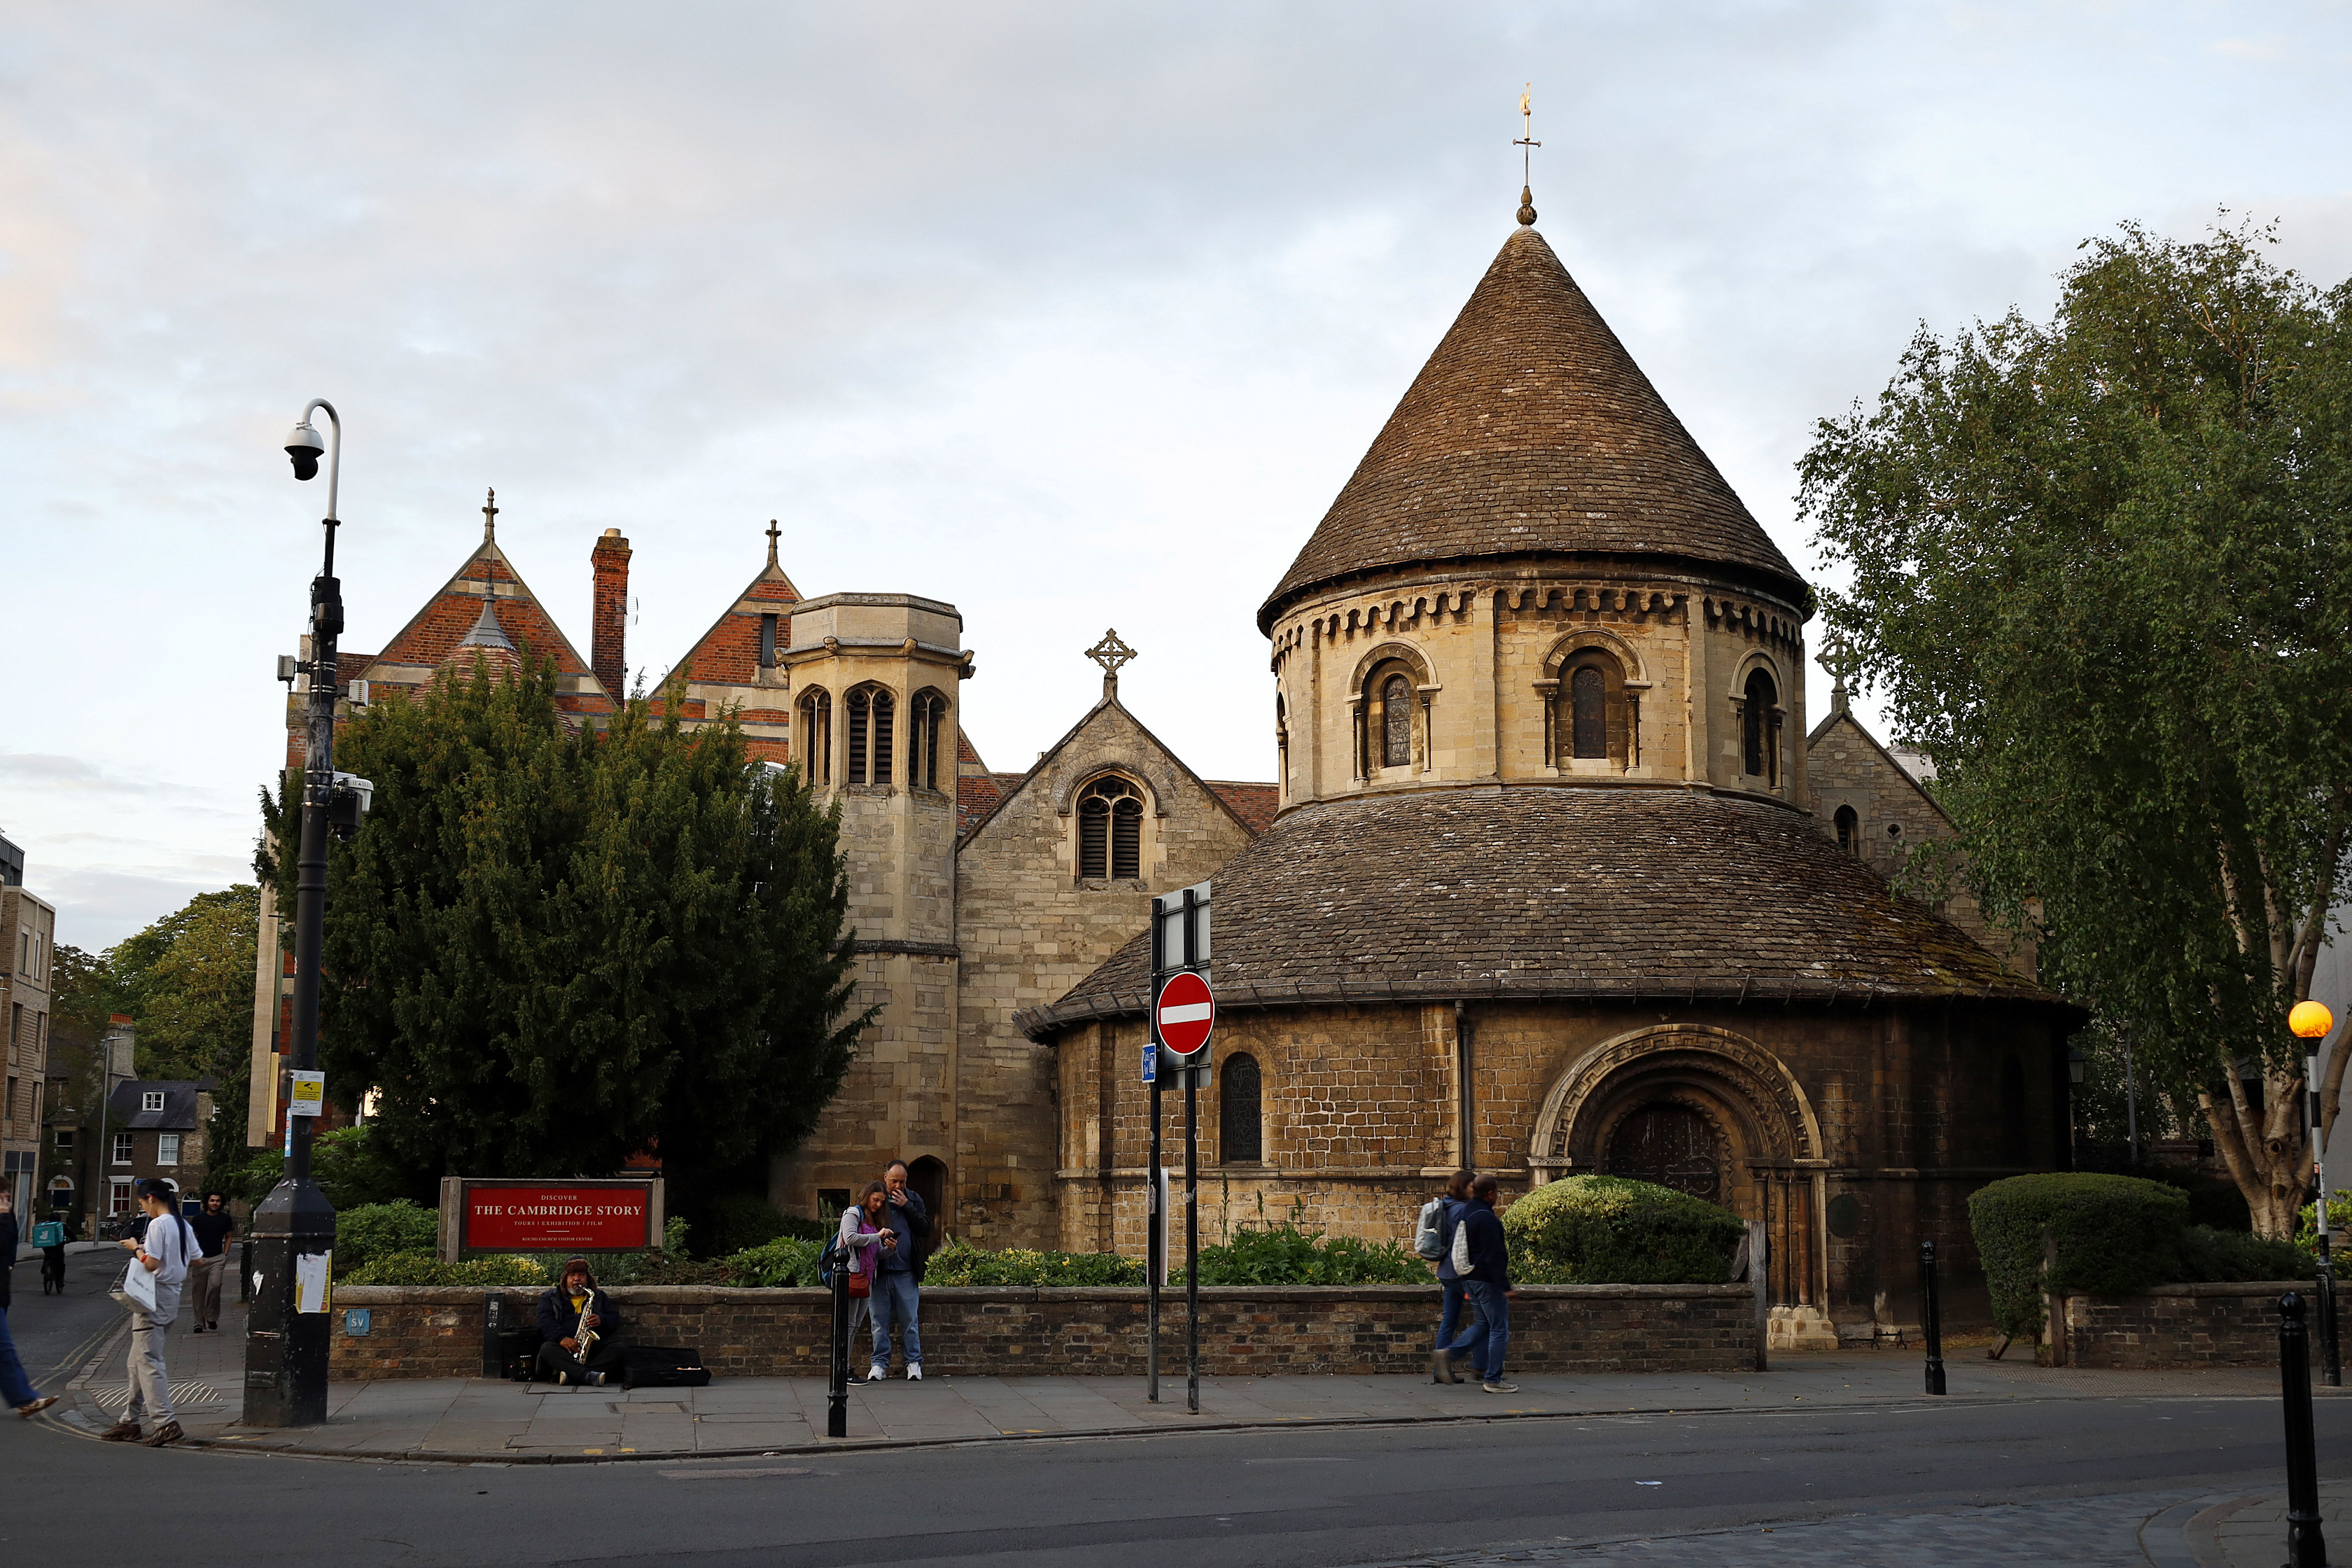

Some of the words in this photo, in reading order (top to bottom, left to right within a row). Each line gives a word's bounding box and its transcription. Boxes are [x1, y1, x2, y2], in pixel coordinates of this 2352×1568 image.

[474, 1205, 503, 1215] THE
[507, 1205, 592, 1215] CAMBRIDGE
[596, 1205, 642, 1215] STORY
[351, 1317, 364, 1327] SV
